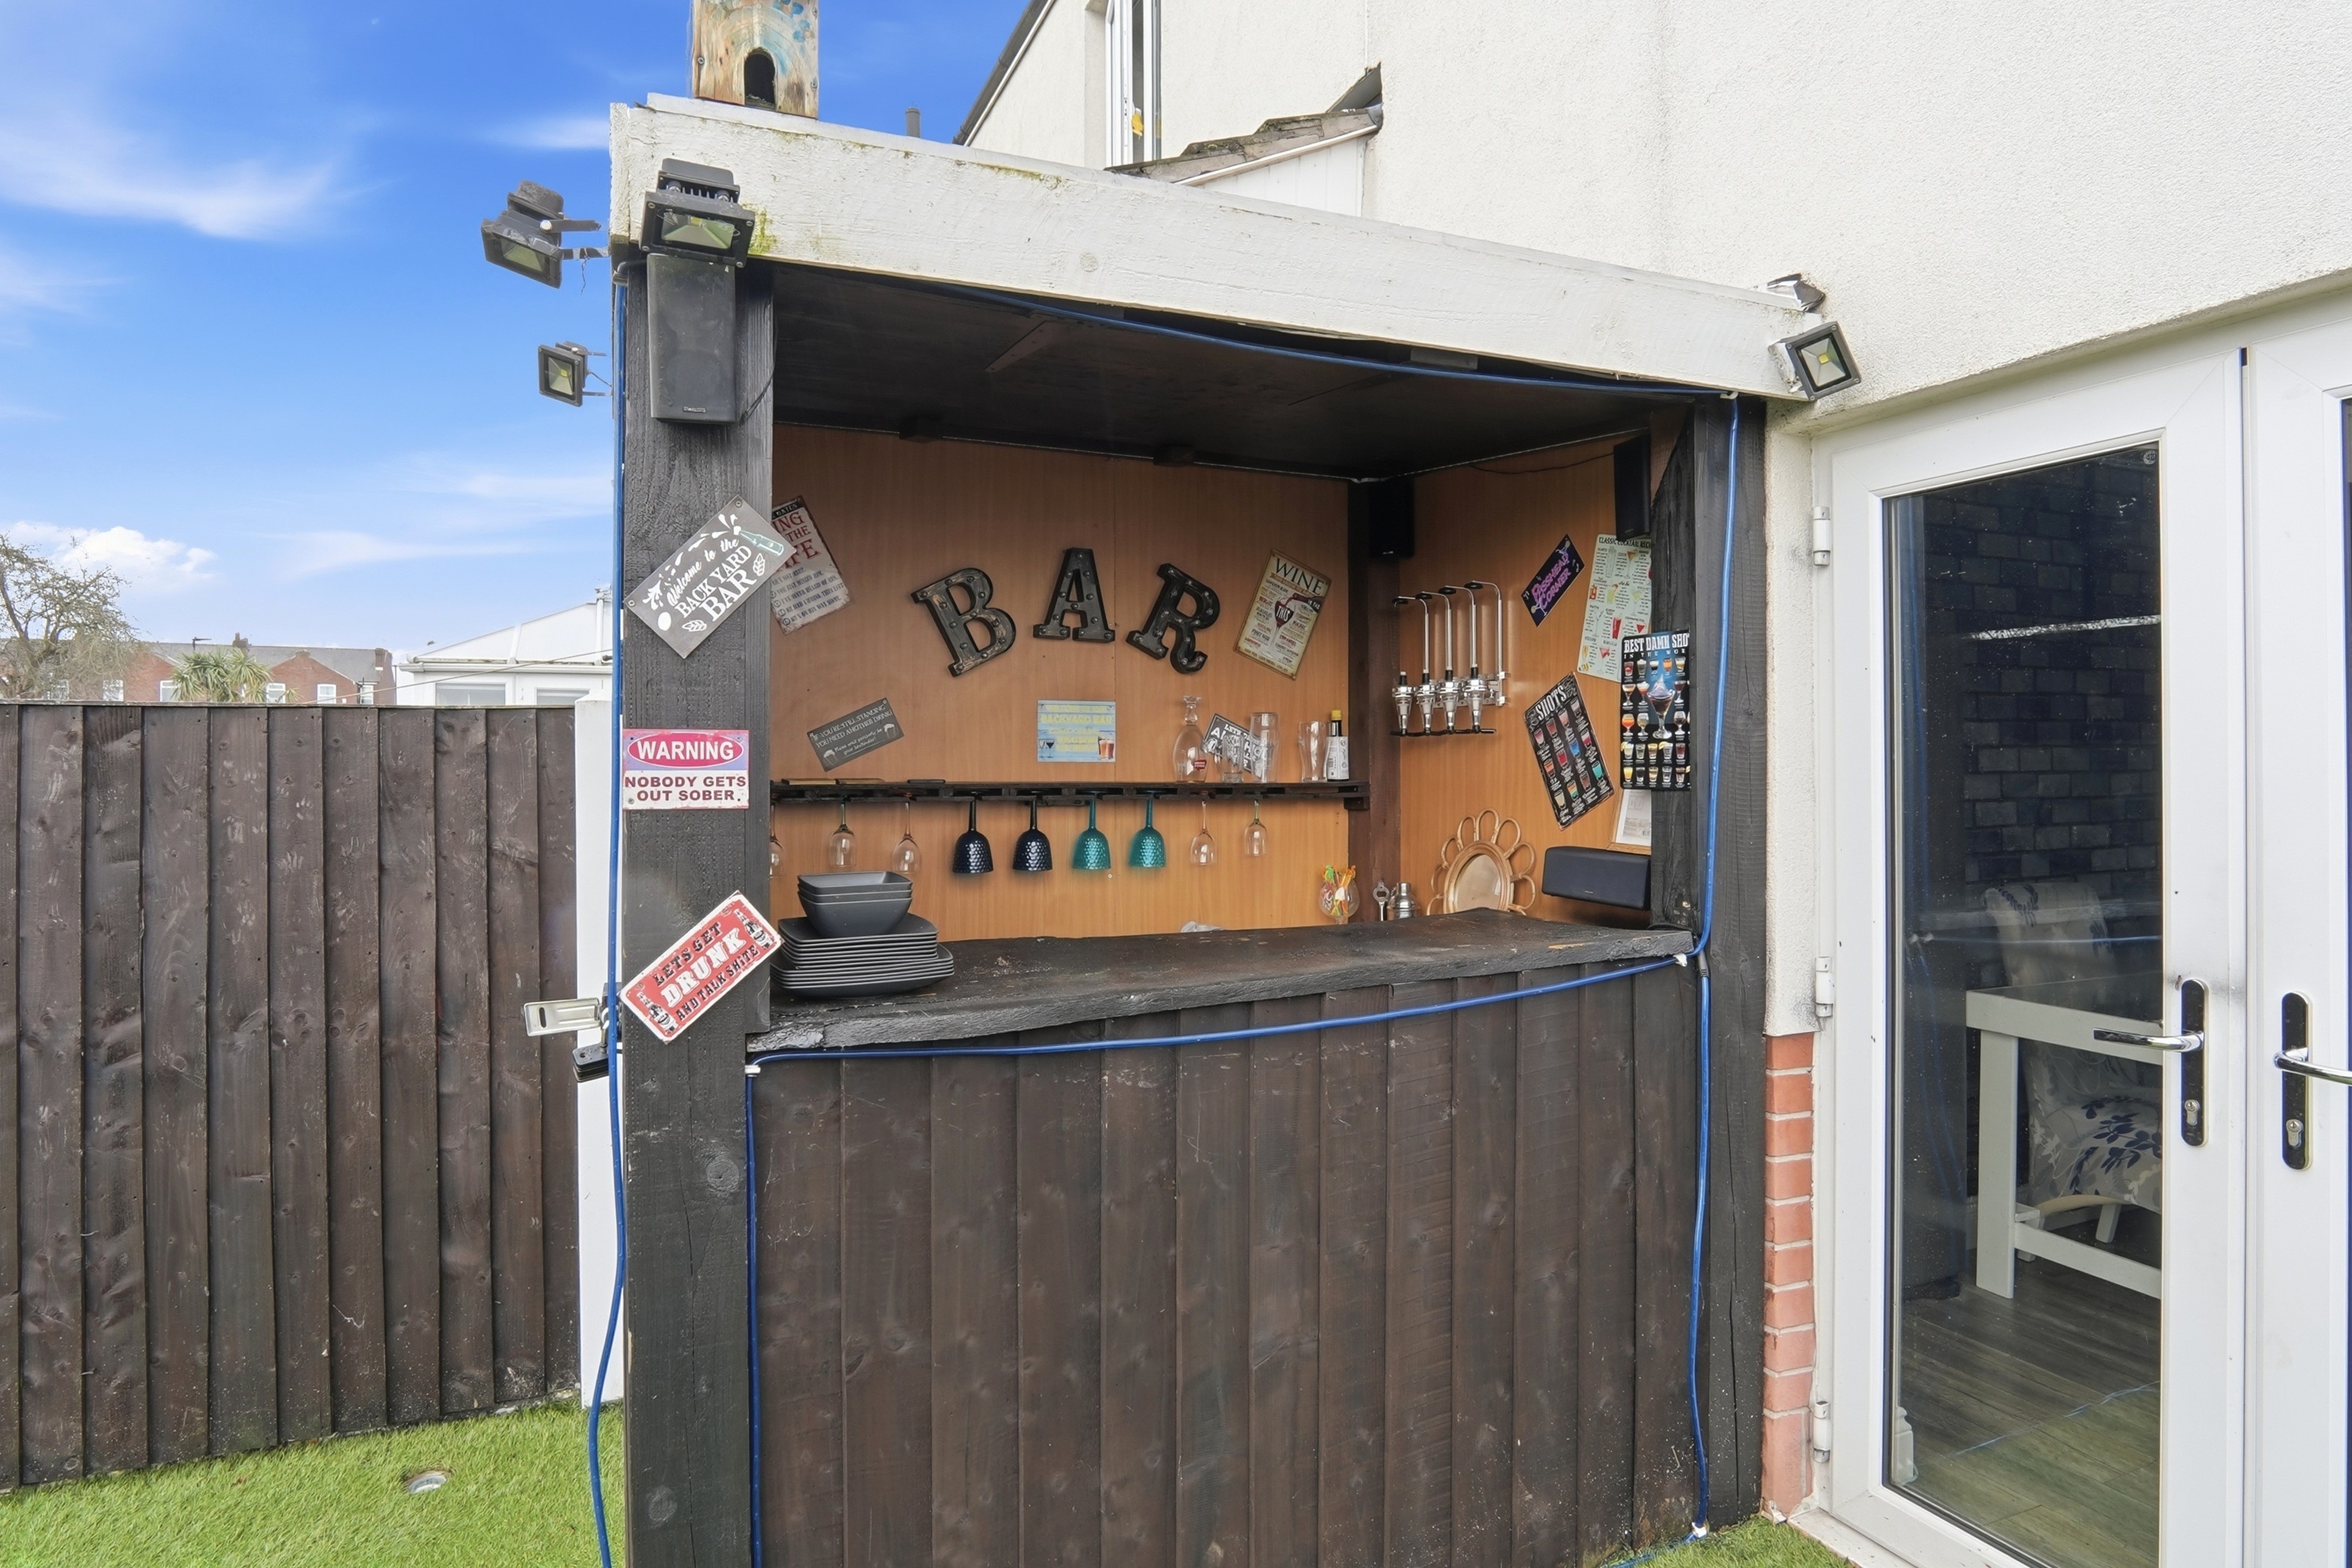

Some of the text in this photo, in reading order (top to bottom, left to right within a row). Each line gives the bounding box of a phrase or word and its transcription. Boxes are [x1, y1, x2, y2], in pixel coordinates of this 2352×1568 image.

[785, 525, 811, 541] THE
[666, 537, 740, 607] Welcome to the
[1275, 558, 1324, 595] WINE
[1539, 568, 1571, 609] CORNER
[699, 569, 758, 622] BAR
[911, 547, 1220, 678] BAR
[1624, 638, 1644, 653] BEST
[1646, 636, 1670, 651] DAMN
[1535, 685, 1567, 721] SHOTS
[637, 741, 734, 760] WARNING
[625, 776, 746, 788] NOBODY GETS
[637, 790, 734, 801] OUT SOBER
[693, 922, 721, 951] GET
[660, 927, 746, 1008] DRUNK
[675, 998, 699, 1021] AND
[697, 973, 727, 1001] TALK
